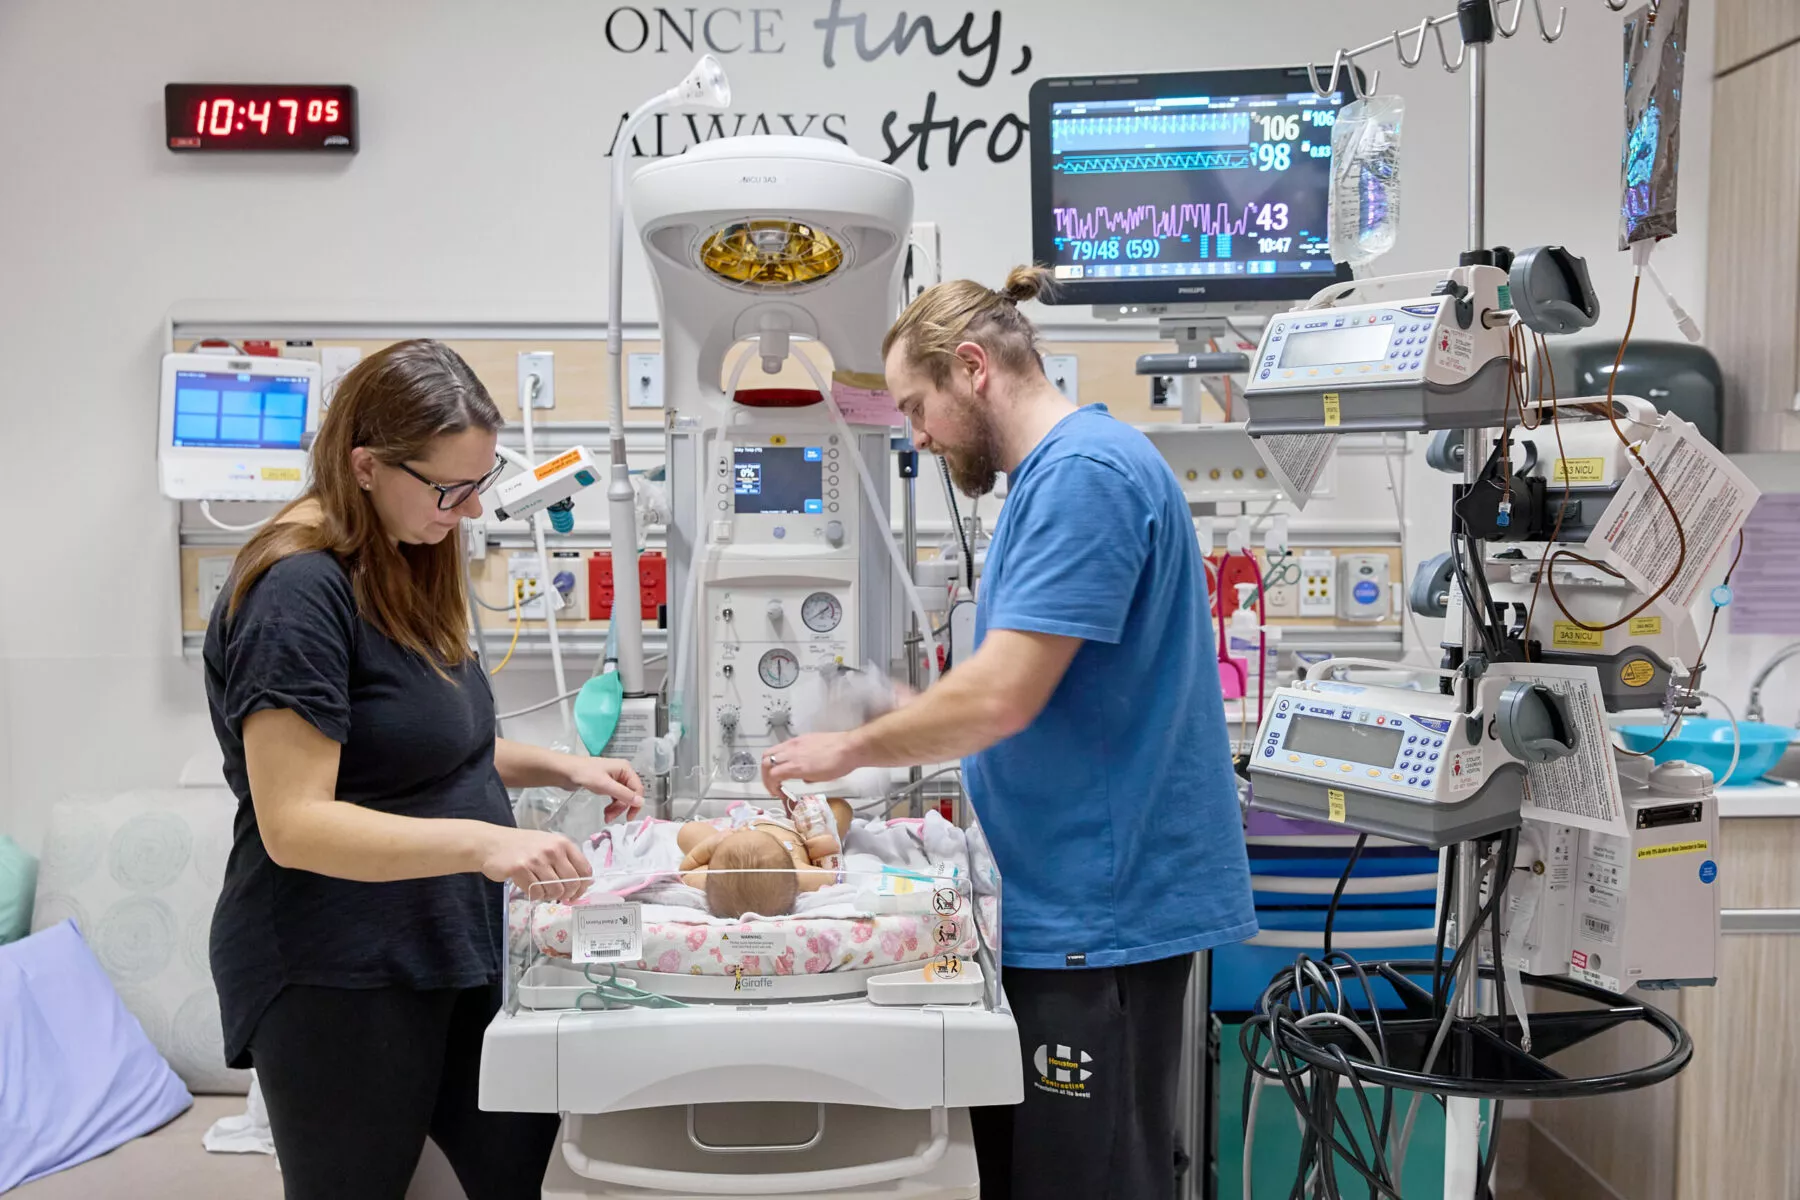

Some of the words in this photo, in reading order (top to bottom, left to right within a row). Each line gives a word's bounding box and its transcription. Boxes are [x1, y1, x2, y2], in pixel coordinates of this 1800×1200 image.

[605, 6, 786, 54] ONCE
[813, 0, 1032, 87] tiny,
[196, 99, 299, 136] 10:47
[307, 100, 339, 122] 05
[1260, 114, 1300, 141] 106
[1259, 142, 1291, 172] 98
[1256, 203, 1289, 231] 43
[1070, 240, 1119, 260] 79/48
[1125, 238, 1160, 259] (59)
[1257, 236, 1292, 253] 10:47
[1560, 465, 1573, 474] 33
[1575, 465, 1594, 474] NICU
[1560, 631, 1573, 639] 3A3
[1575, 631, 1593, 640] NICU
[741, 978, 773, 988] Giraffe
[1048, 1057, 1078, 1069] Houston
